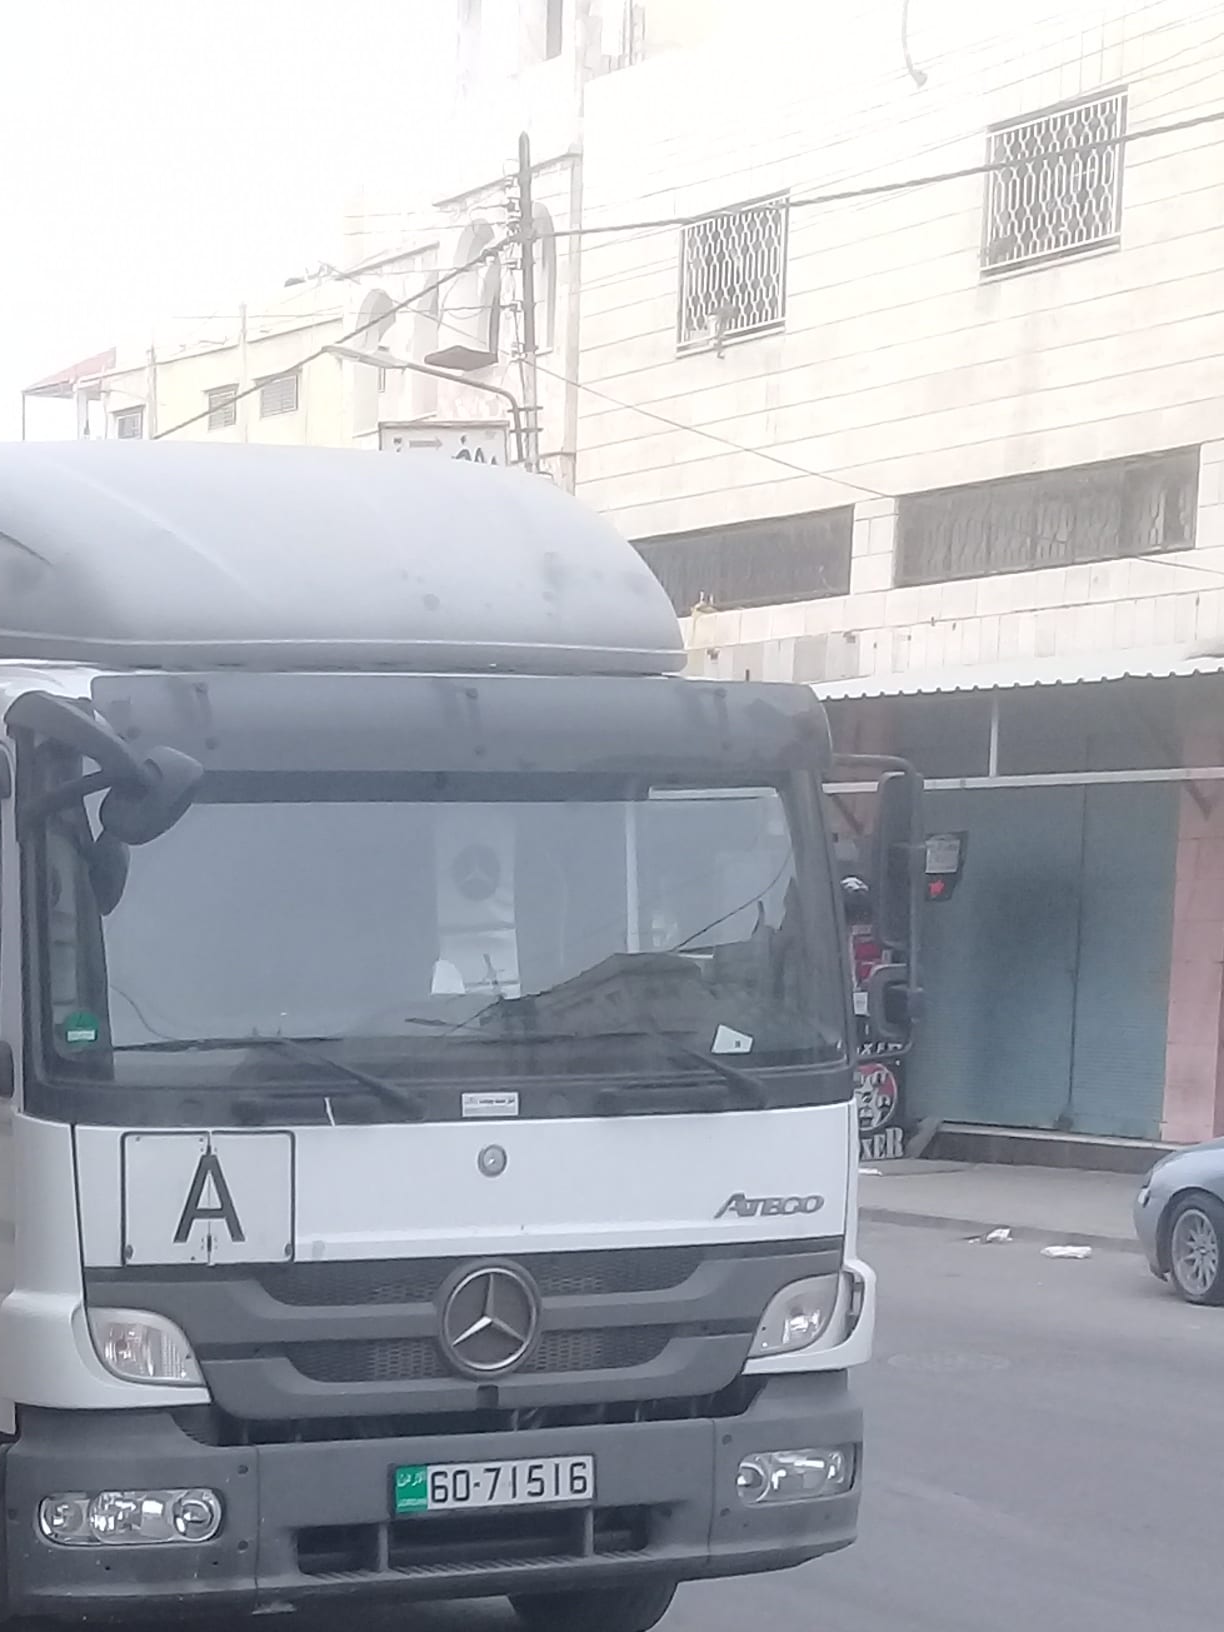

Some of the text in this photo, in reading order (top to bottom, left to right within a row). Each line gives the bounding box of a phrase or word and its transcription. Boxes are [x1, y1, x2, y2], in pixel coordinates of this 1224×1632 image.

[861, 1126, 904, 1160] XER
[173, 1153, 246, 1243] A
[430, 1461, 587, 1504] 60-71516
